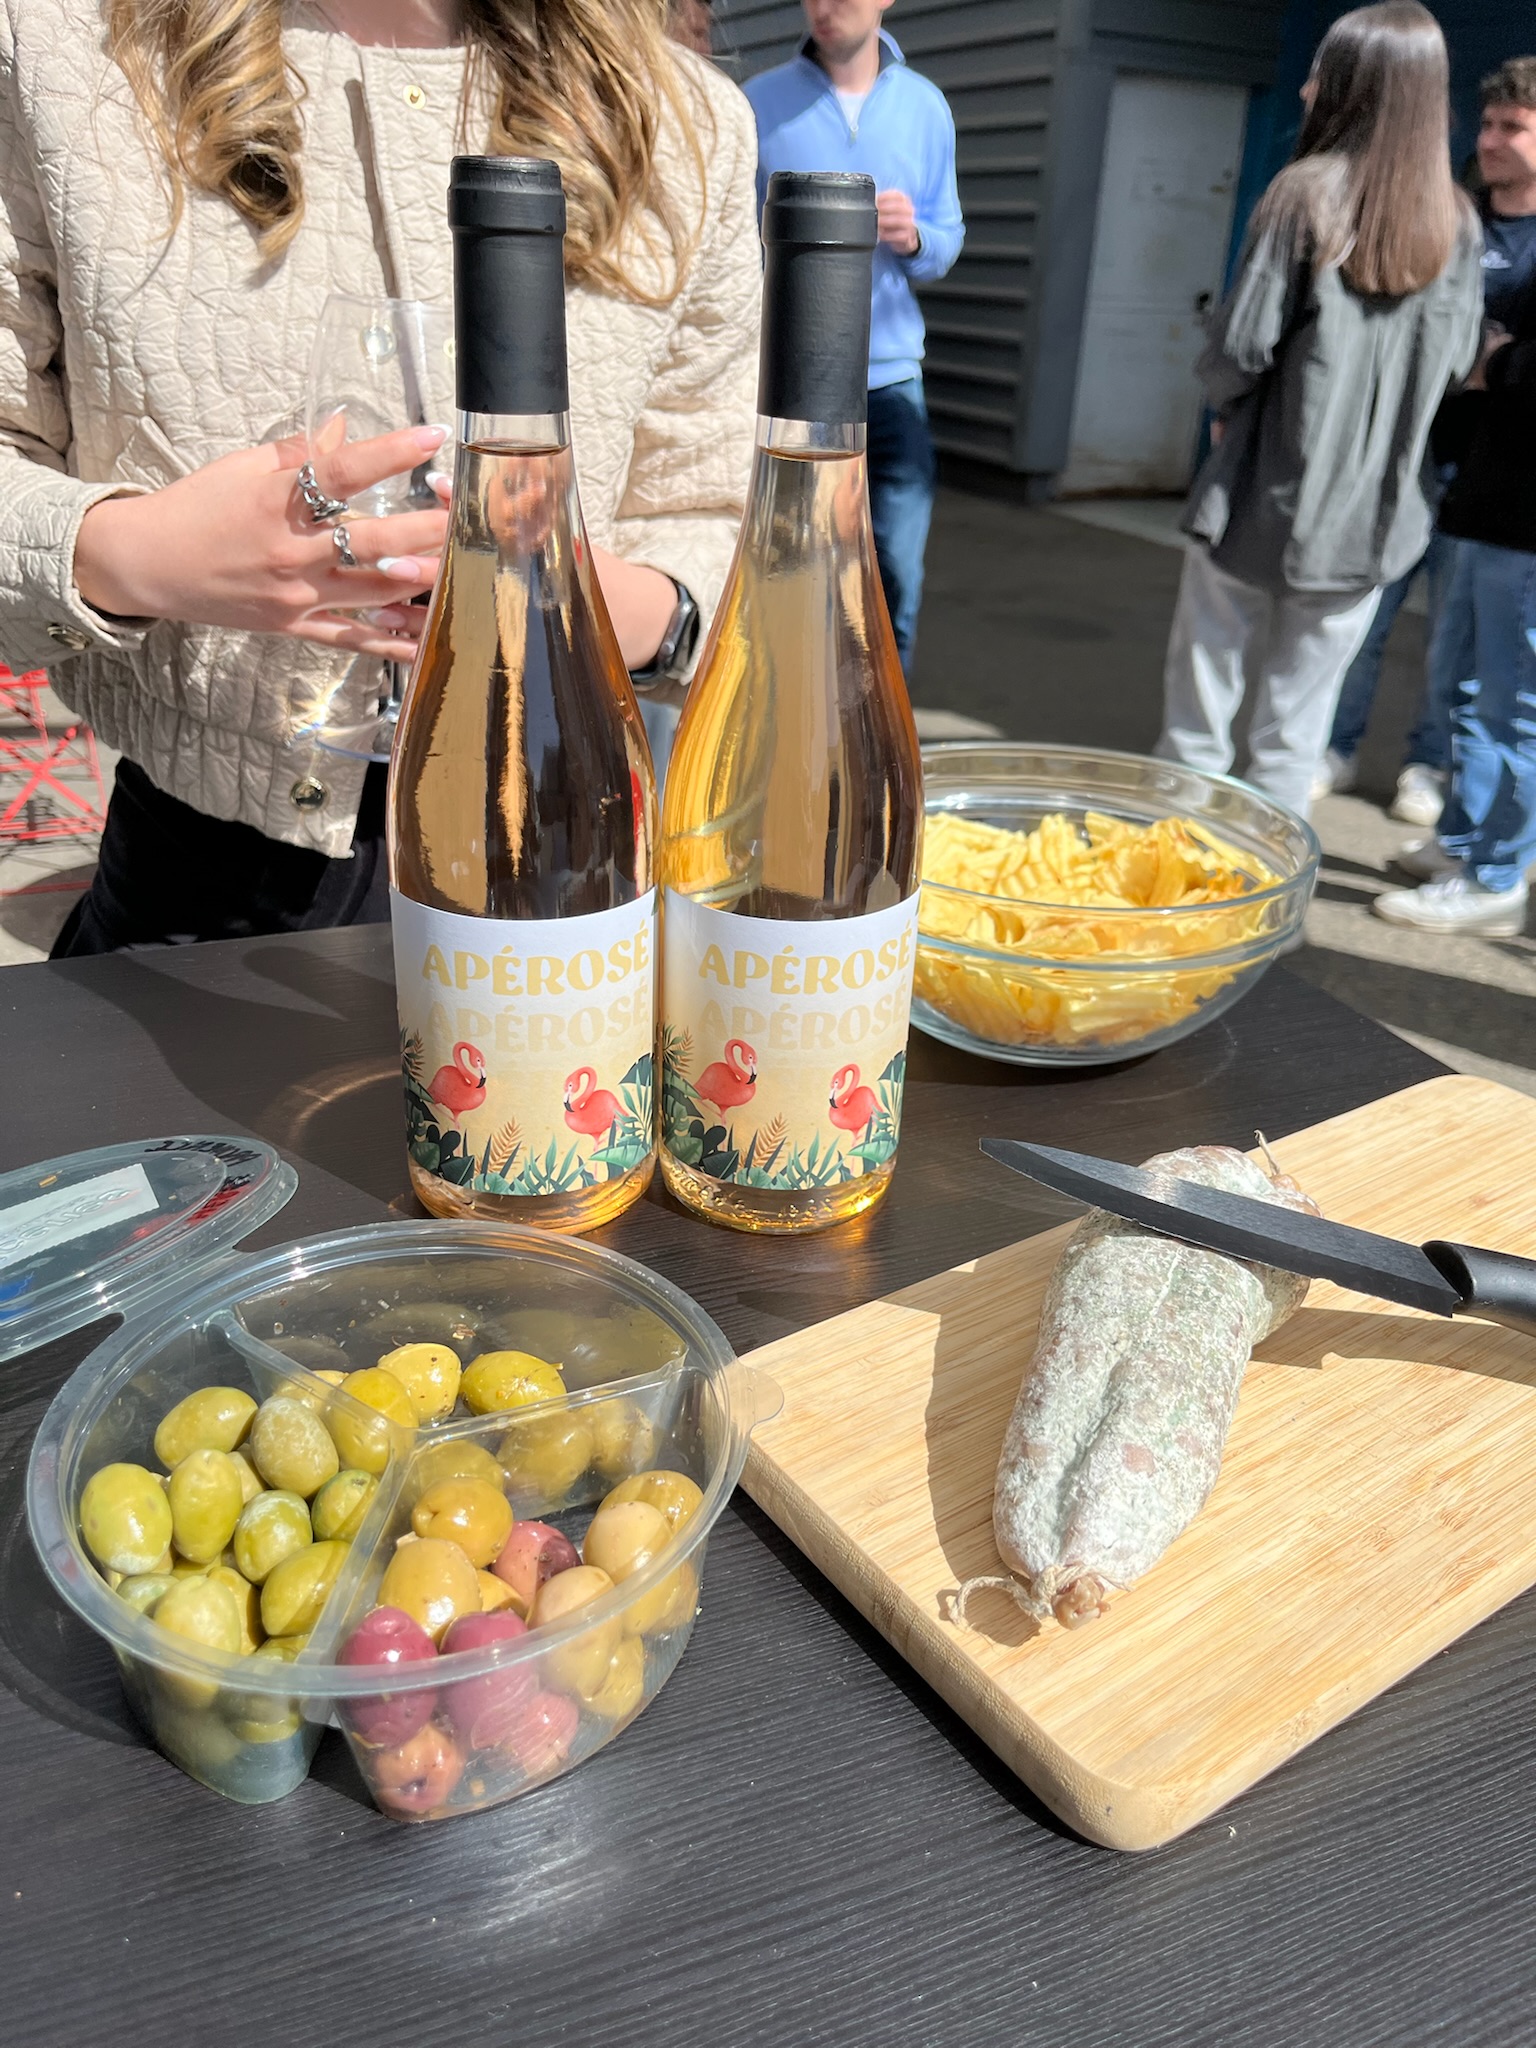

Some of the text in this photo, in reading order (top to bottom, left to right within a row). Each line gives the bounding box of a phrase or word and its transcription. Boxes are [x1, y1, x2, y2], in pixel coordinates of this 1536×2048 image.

[422, 921, 649, 996] APÉROSÉ
[698, 920, 913, 995] APÉROSÉ
[425, 979, 649, 1052] APÉROSÉ
[698, 976, 908, 1052] APÉROSÉ
